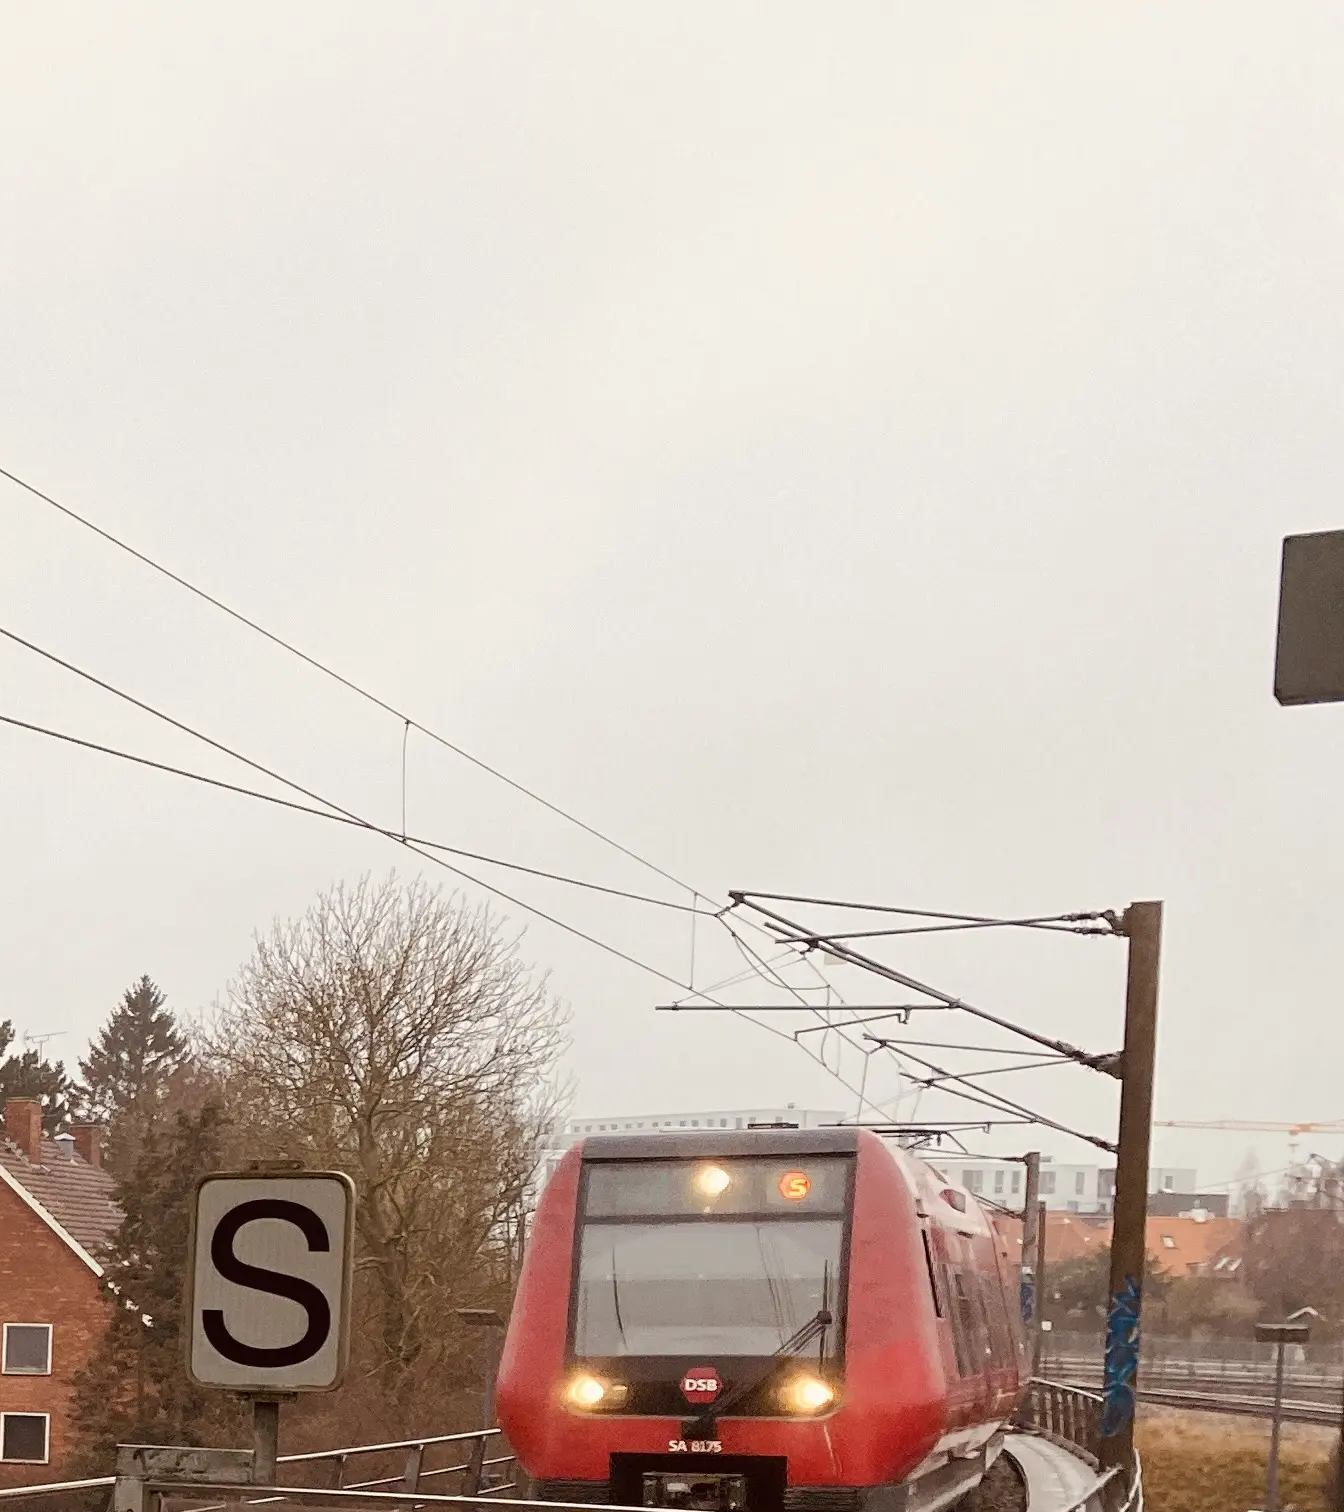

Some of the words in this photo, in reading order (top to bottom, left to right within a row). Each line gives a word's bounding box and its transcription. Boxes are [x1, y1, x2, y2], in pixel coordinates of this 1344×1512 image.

[202, 1199, 331, 1368] S
[684, 1378, 718, 1392] DSB
[668, 1440, 688, 1452] SA
[691, 1440, 722, 1453] 8175
